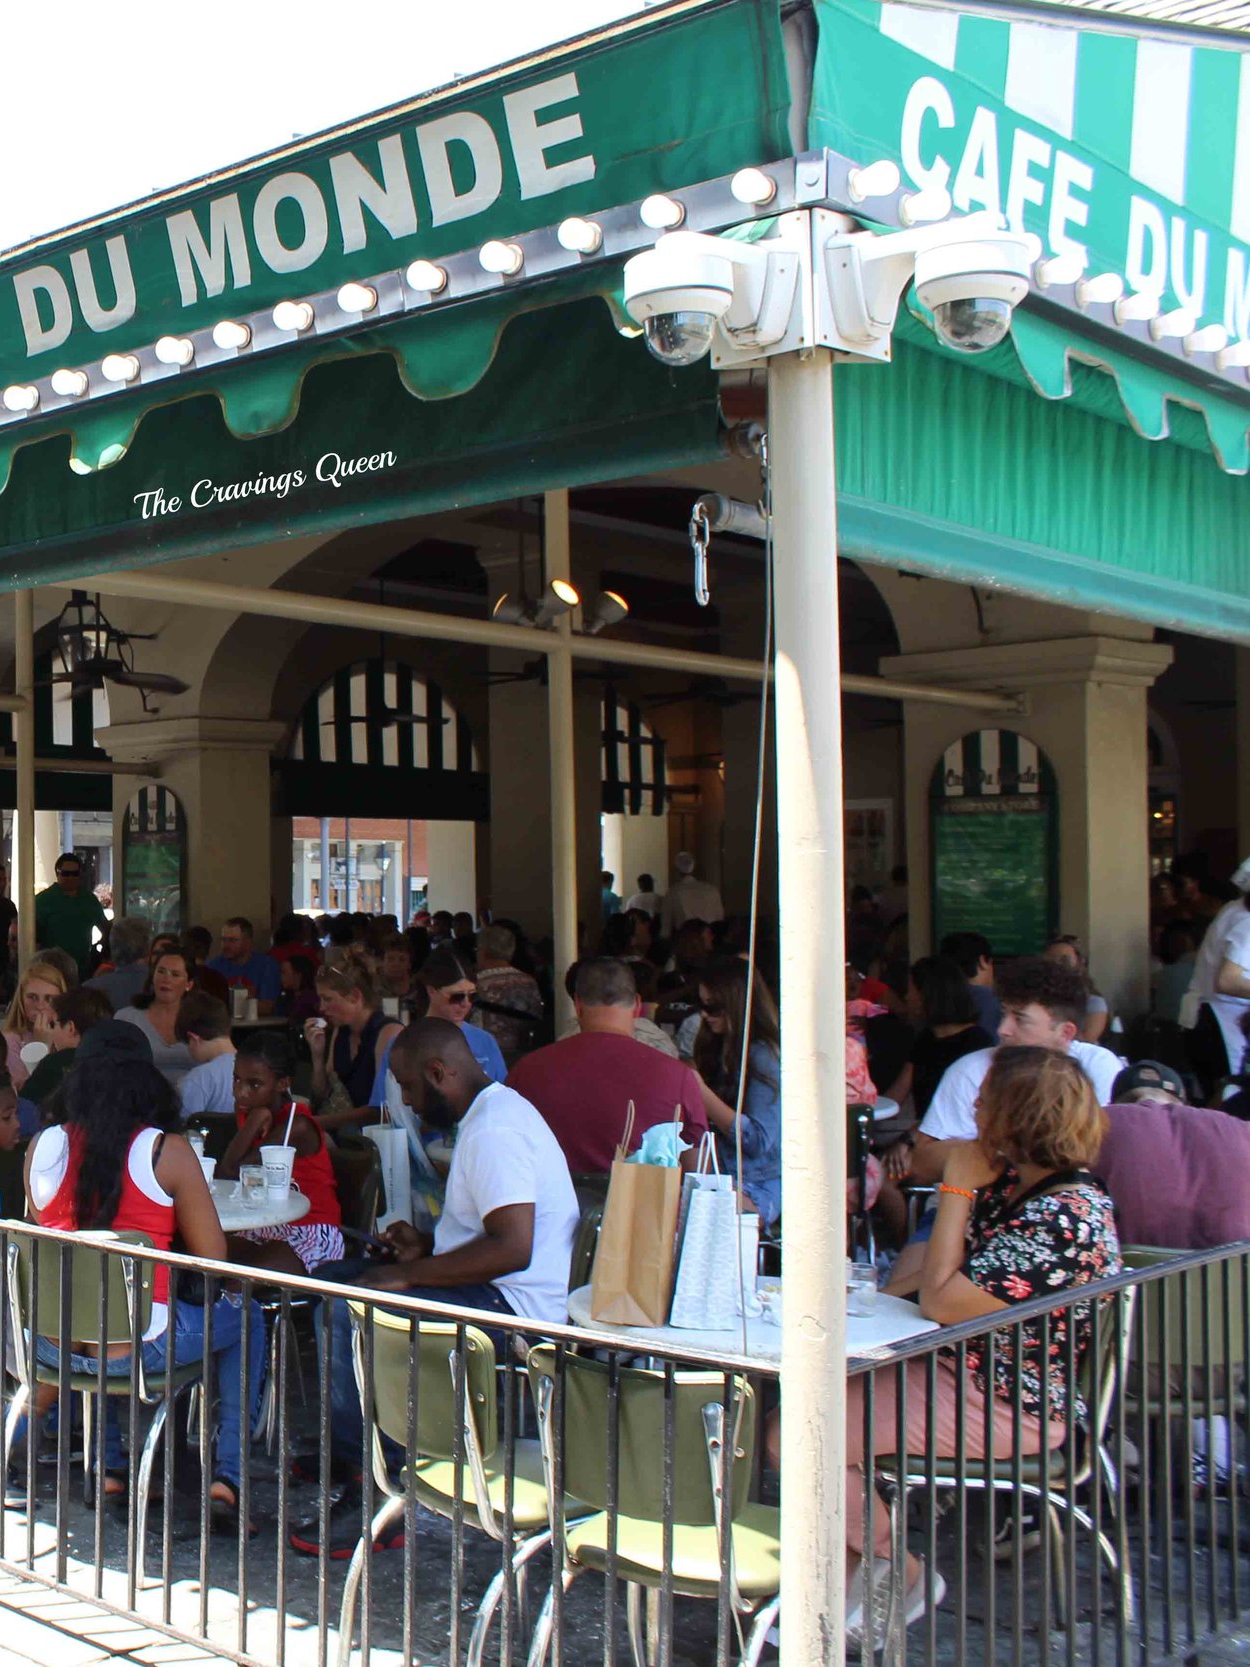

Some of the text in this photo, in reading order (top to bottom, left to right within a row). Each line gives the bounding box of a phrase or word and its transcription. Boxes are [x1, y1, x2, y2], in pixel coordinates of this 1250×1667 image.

[12, 235, 137, 358] DU
[165, 72, 595, 308] MONDE
[901, 76, 1094, 268] CAFE
[1126, 195, 1207, 318] DU
